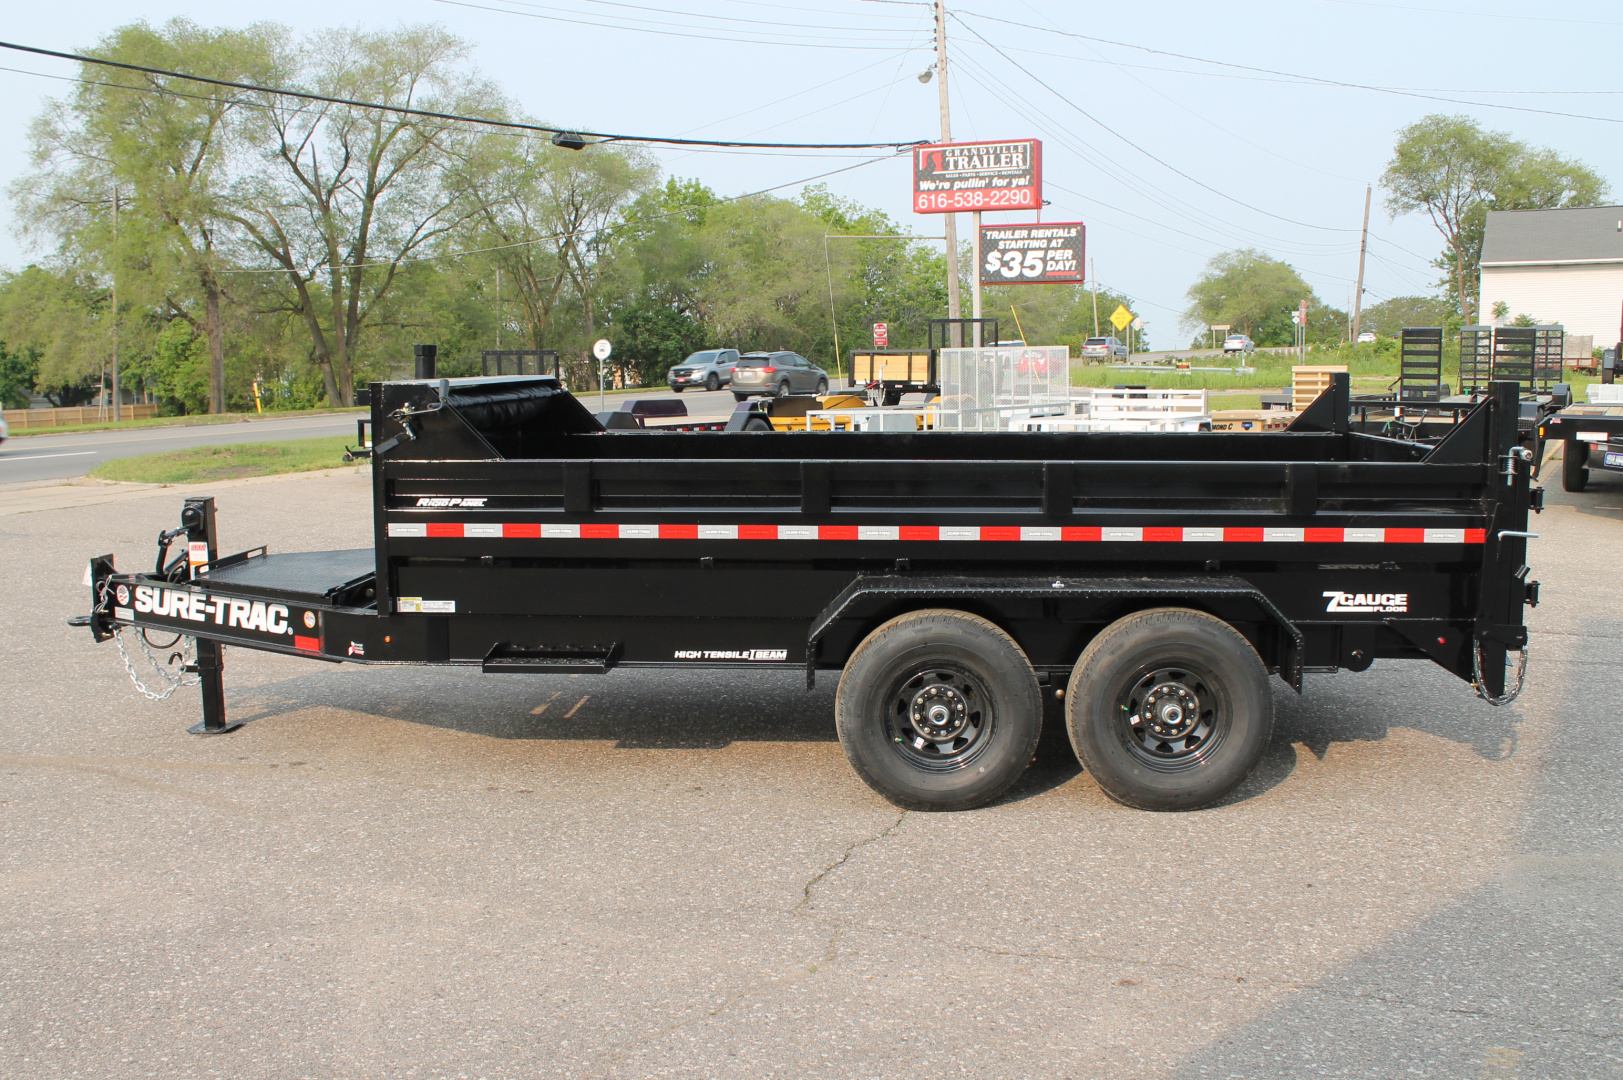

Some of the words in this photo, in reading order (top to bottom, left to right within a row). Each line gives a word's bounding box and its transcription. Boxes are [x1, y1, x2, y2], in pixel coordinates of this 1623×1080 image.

[945, 145, 1024, 157] GRANDVILLE
[945, 153, 1024, 171] TRAILER
[919, 180, 950, 191] We're
[953, 177, 989, 190] pullin'
[992, 177, 1009, 187] for
[1011, 175, 1030, 188] ya!
[918, 188, 1030, 209] 616-538-2290
[985, 230, 1028, 240] TRAILER
[1030, 228, 1078, 239] RENTALS
[997, 239, 1048, 249] STARTING
[1049, 238, 1064, 248] AT
[1046, 249, 1073, 260] PER
[985, 249, 1045, 278] $35
[1046, 260, 1076, 271] DAY!
[134, 585, 289, 635] SURE-TRAC
[674, 650, 702, 659] HIGH
[703, 650, 750, 659] TENSILE
